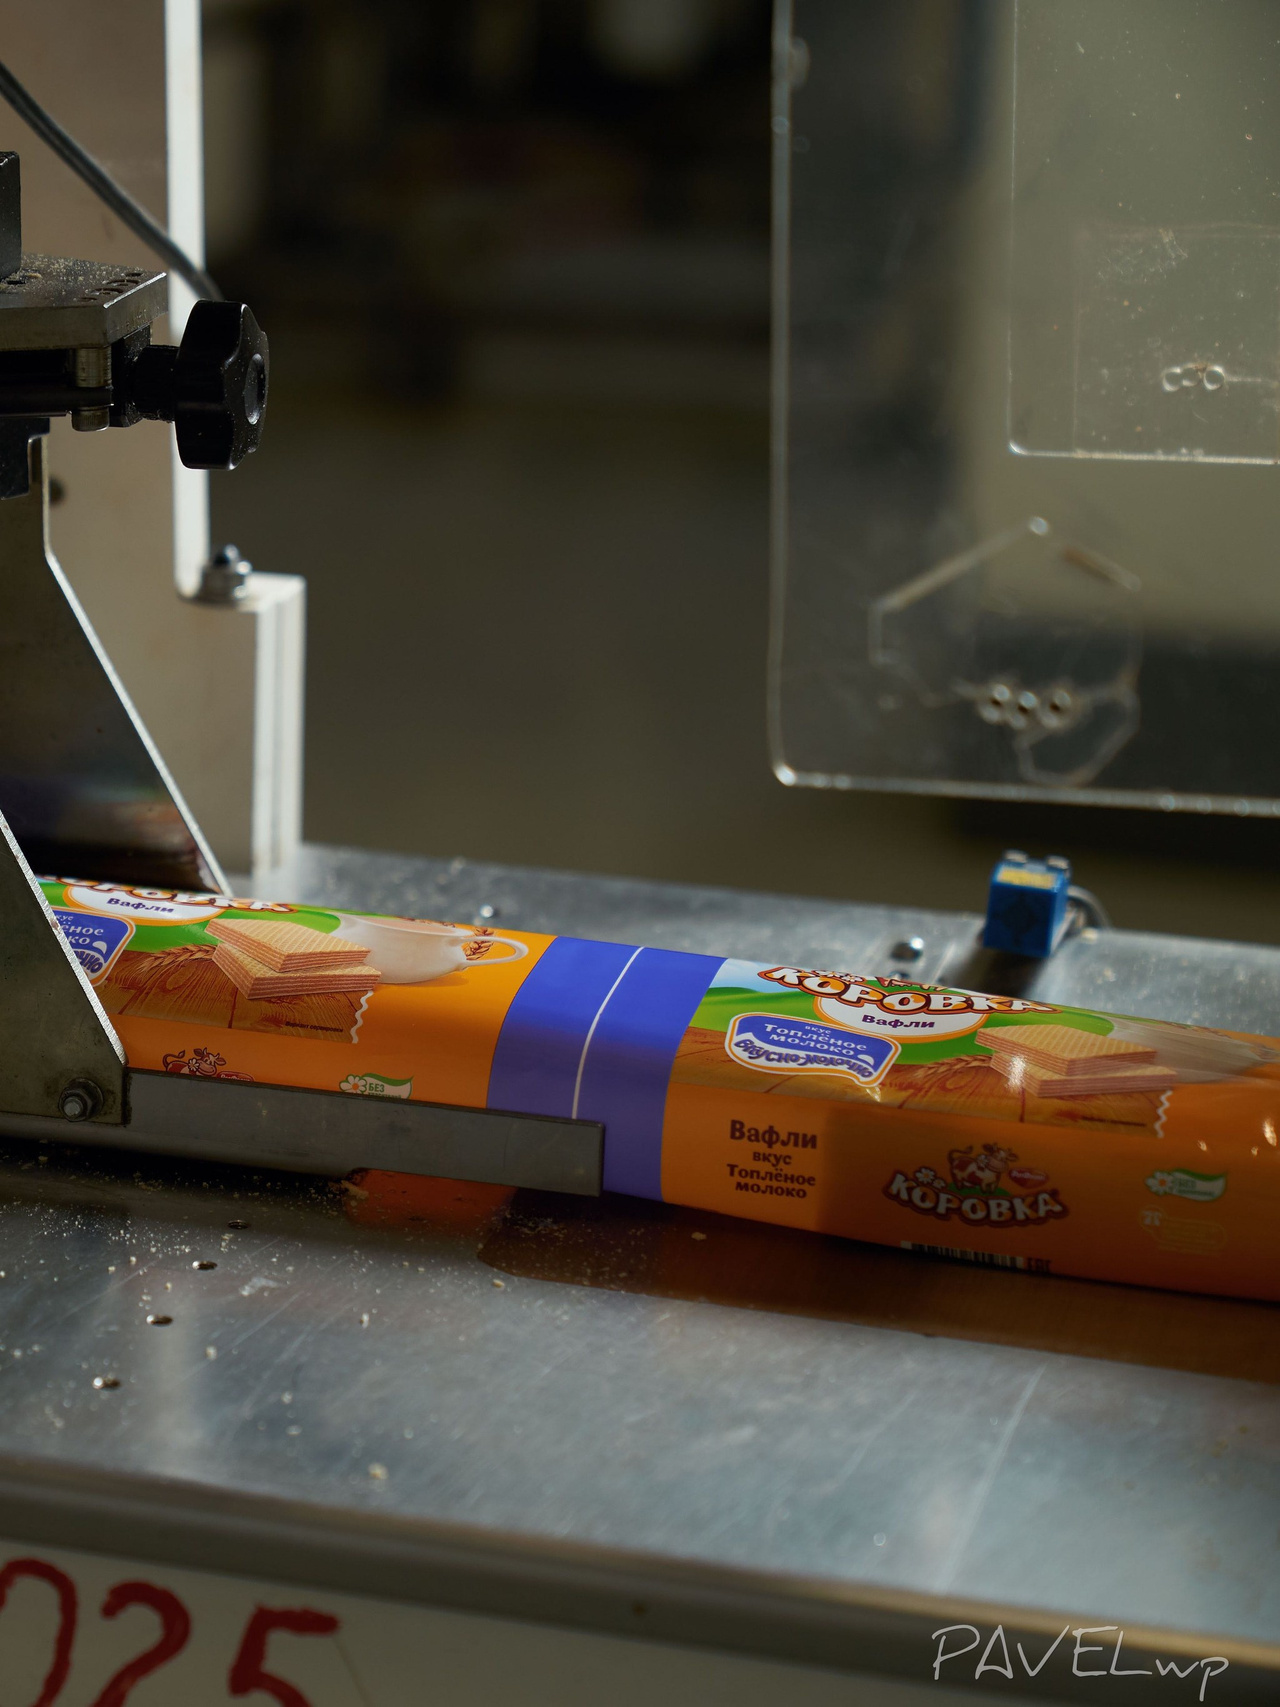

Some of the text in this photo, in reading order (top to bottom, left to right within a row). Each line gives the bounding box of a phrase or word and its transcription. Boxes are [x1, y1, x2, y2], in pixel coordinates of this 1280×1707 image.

[107, 897, 174, 914] Вафли
[54, 914, 75, 923] кус
[61, 920, 105, 936] ёное
[762, 966, 1057, 1013] КОРОВКА
[804, 1025, 832, 1035] вкус
[861, 1014, 935, 1030] Вафли
[764, 1023, 867, 1051] Топлёное
[769, 1033, 855, 1057] молоко
[368, 1082, 385, 1094] БЕЗ
[730, 1119, 818, 1149] Вафли
[752, 1151, 793, 1166] вкус
[726, 1163, 817, 1187] Топлёное
[735, 1181, 808, 1199] молоко
[885, 1170, 1067, 1225] КОРОВКА
